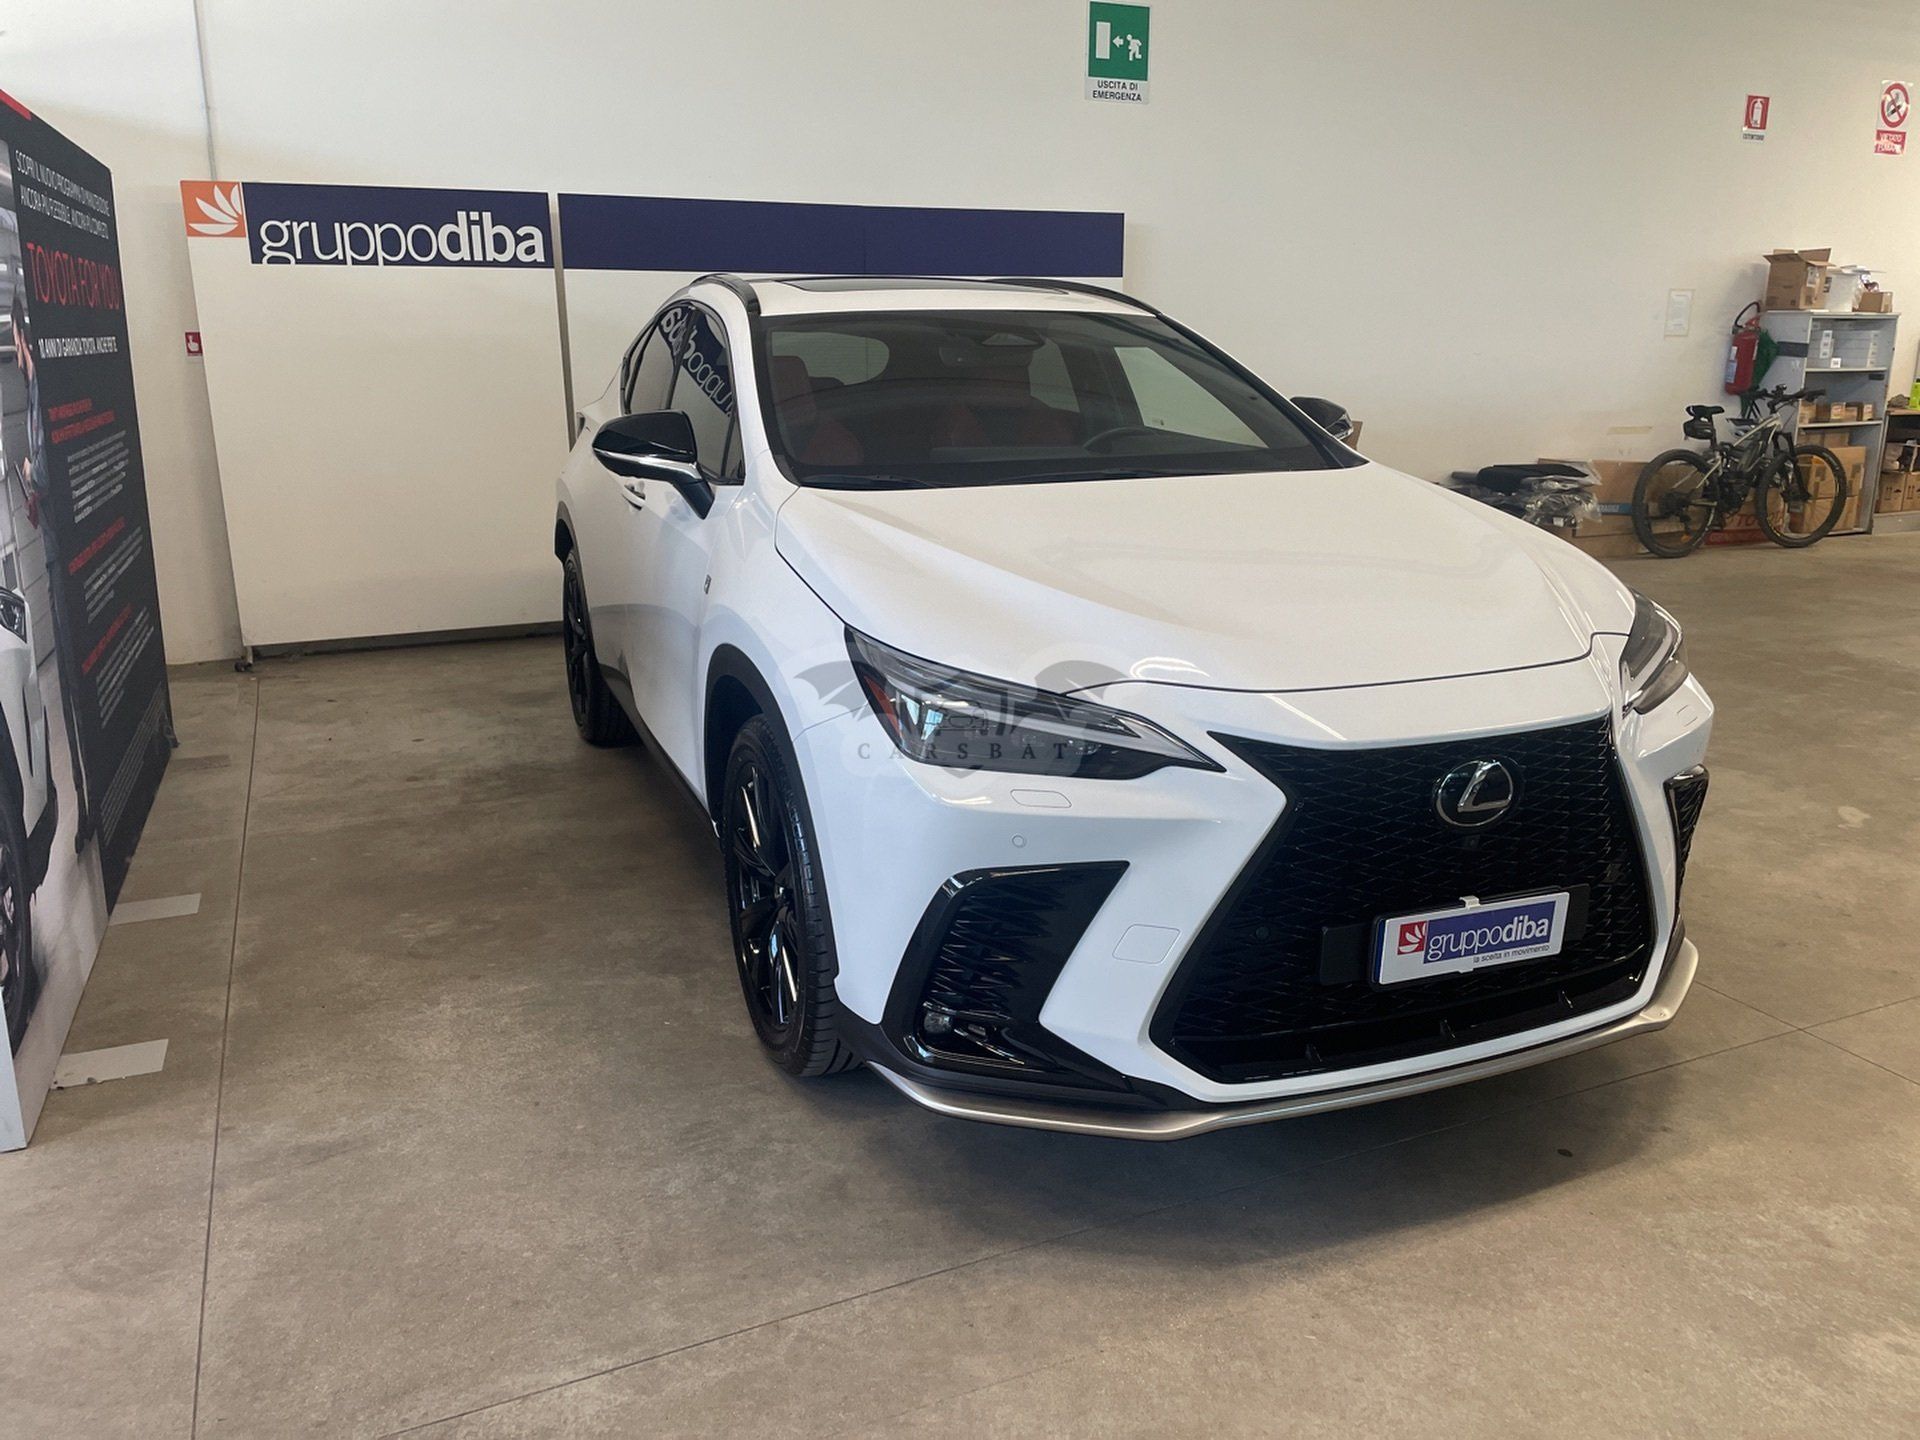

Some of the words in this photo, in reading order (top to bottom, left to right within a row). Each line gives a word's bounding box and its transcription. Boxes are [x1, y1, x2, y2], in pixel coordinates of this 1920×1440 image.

[1092, 90, 1142, 102] EMERGENZA
[1097, 80, 1127, 90] USCITA
[1129, 82, 1138, 91] DI
[259, 210, 545, 266] gruppodiba
[26, 242, 81, 306] TOYOTA
[1427, 915, 1549, 961] gruppodiba
[1481, 952, 1502, 962] scelta
[1512, 945, 1550, 957] movimento
